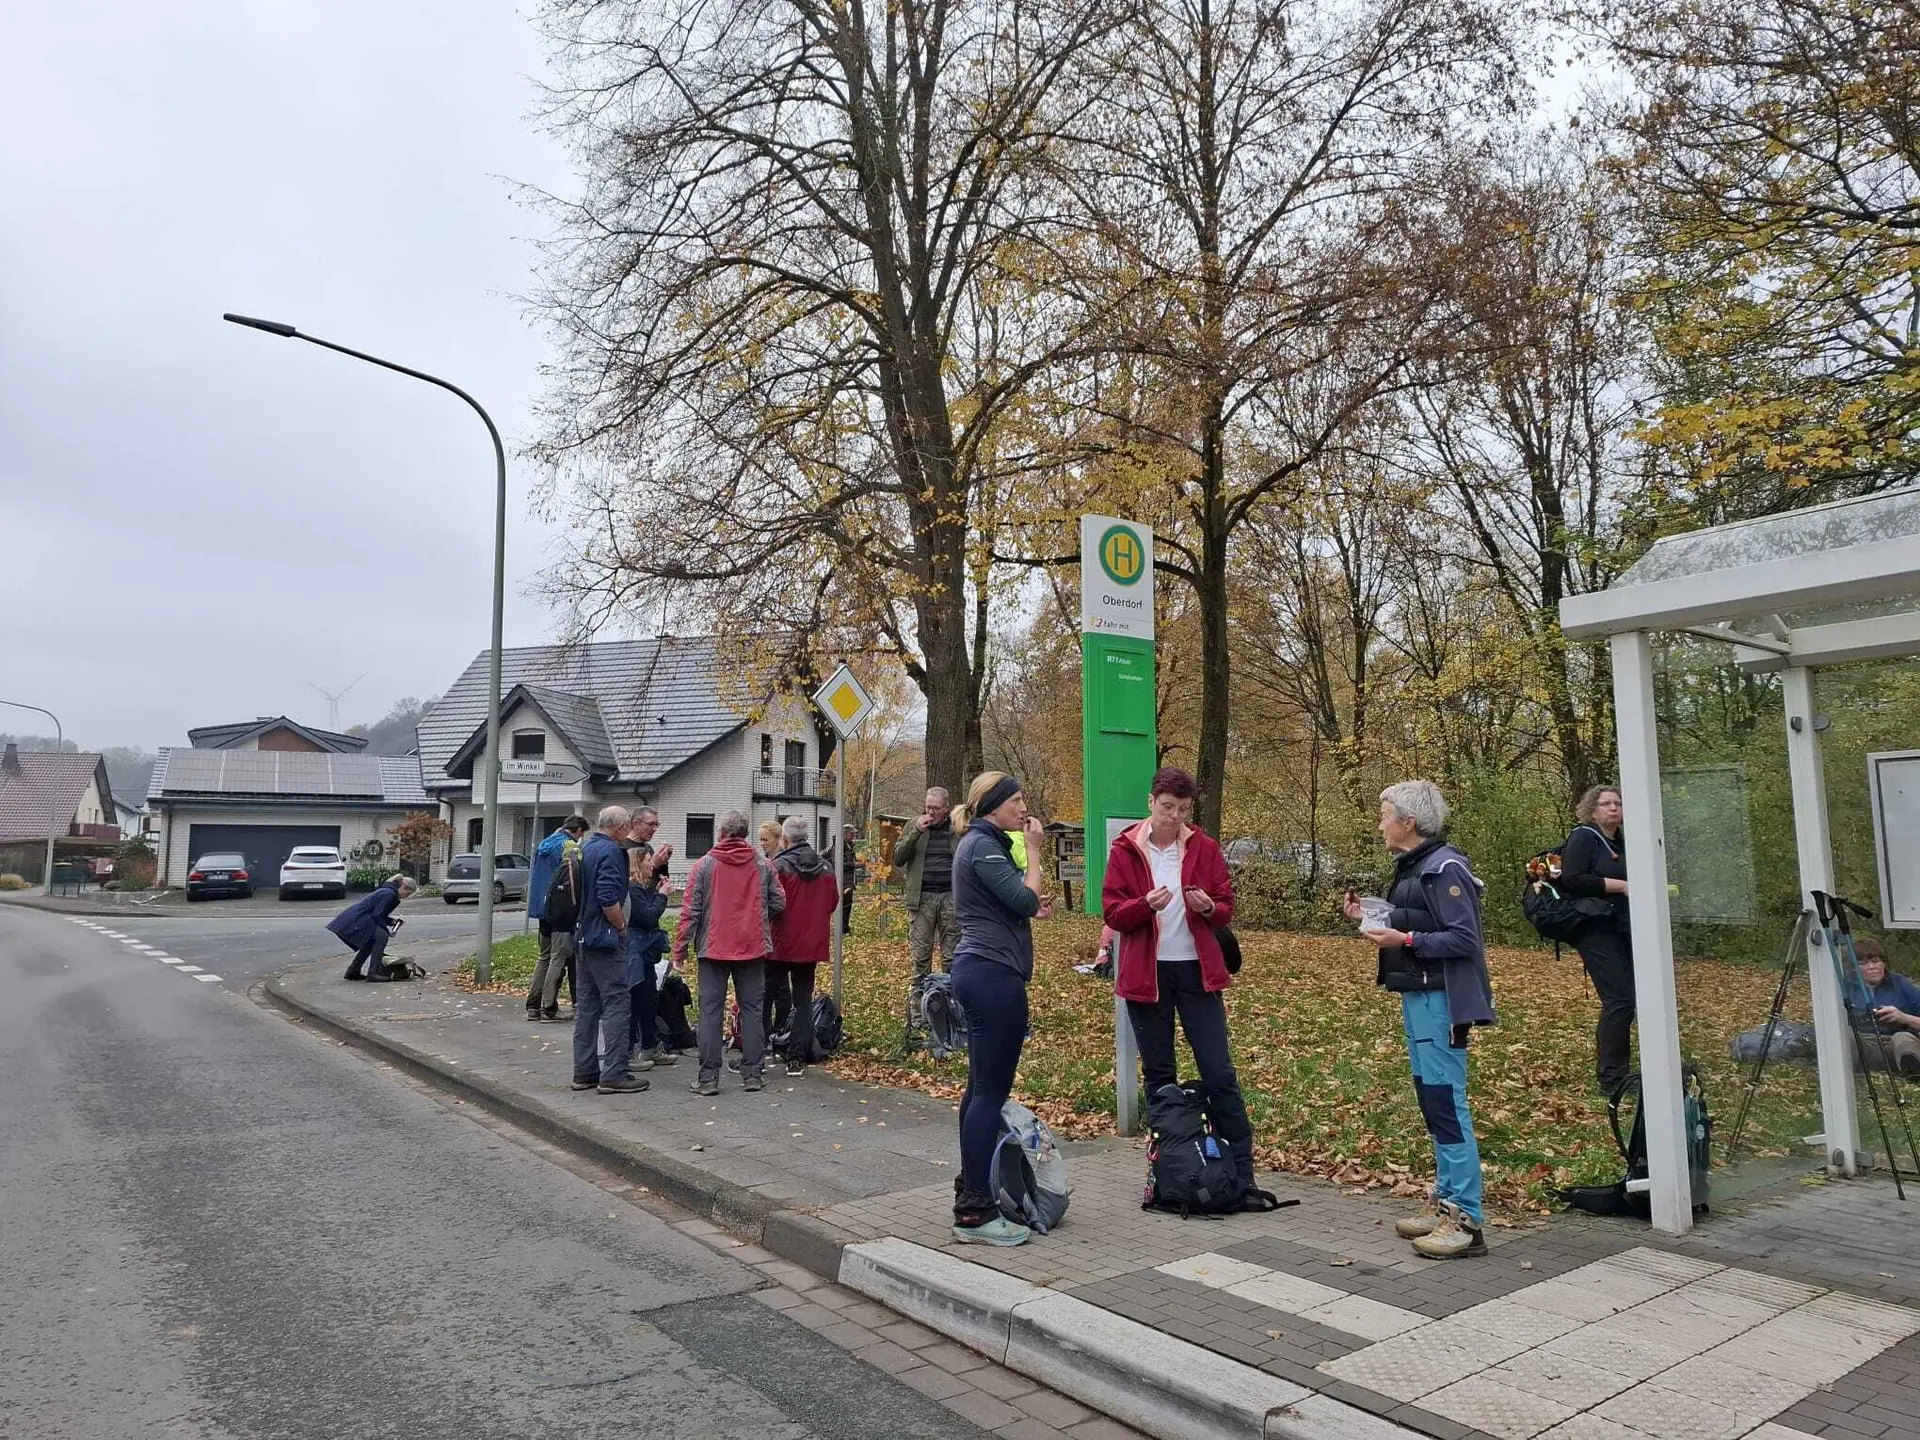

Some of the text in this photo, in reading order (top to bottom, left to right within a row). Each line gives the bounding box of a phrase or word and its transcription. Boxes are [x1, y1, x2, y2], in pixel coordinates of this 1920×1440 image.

[1113, 537, 1133, 573] H
[1102, 595, 1143, 610] Oberdorf
[1104, 620, 1118, 629] fahr
[517, 762, 540, 770] Winkel
